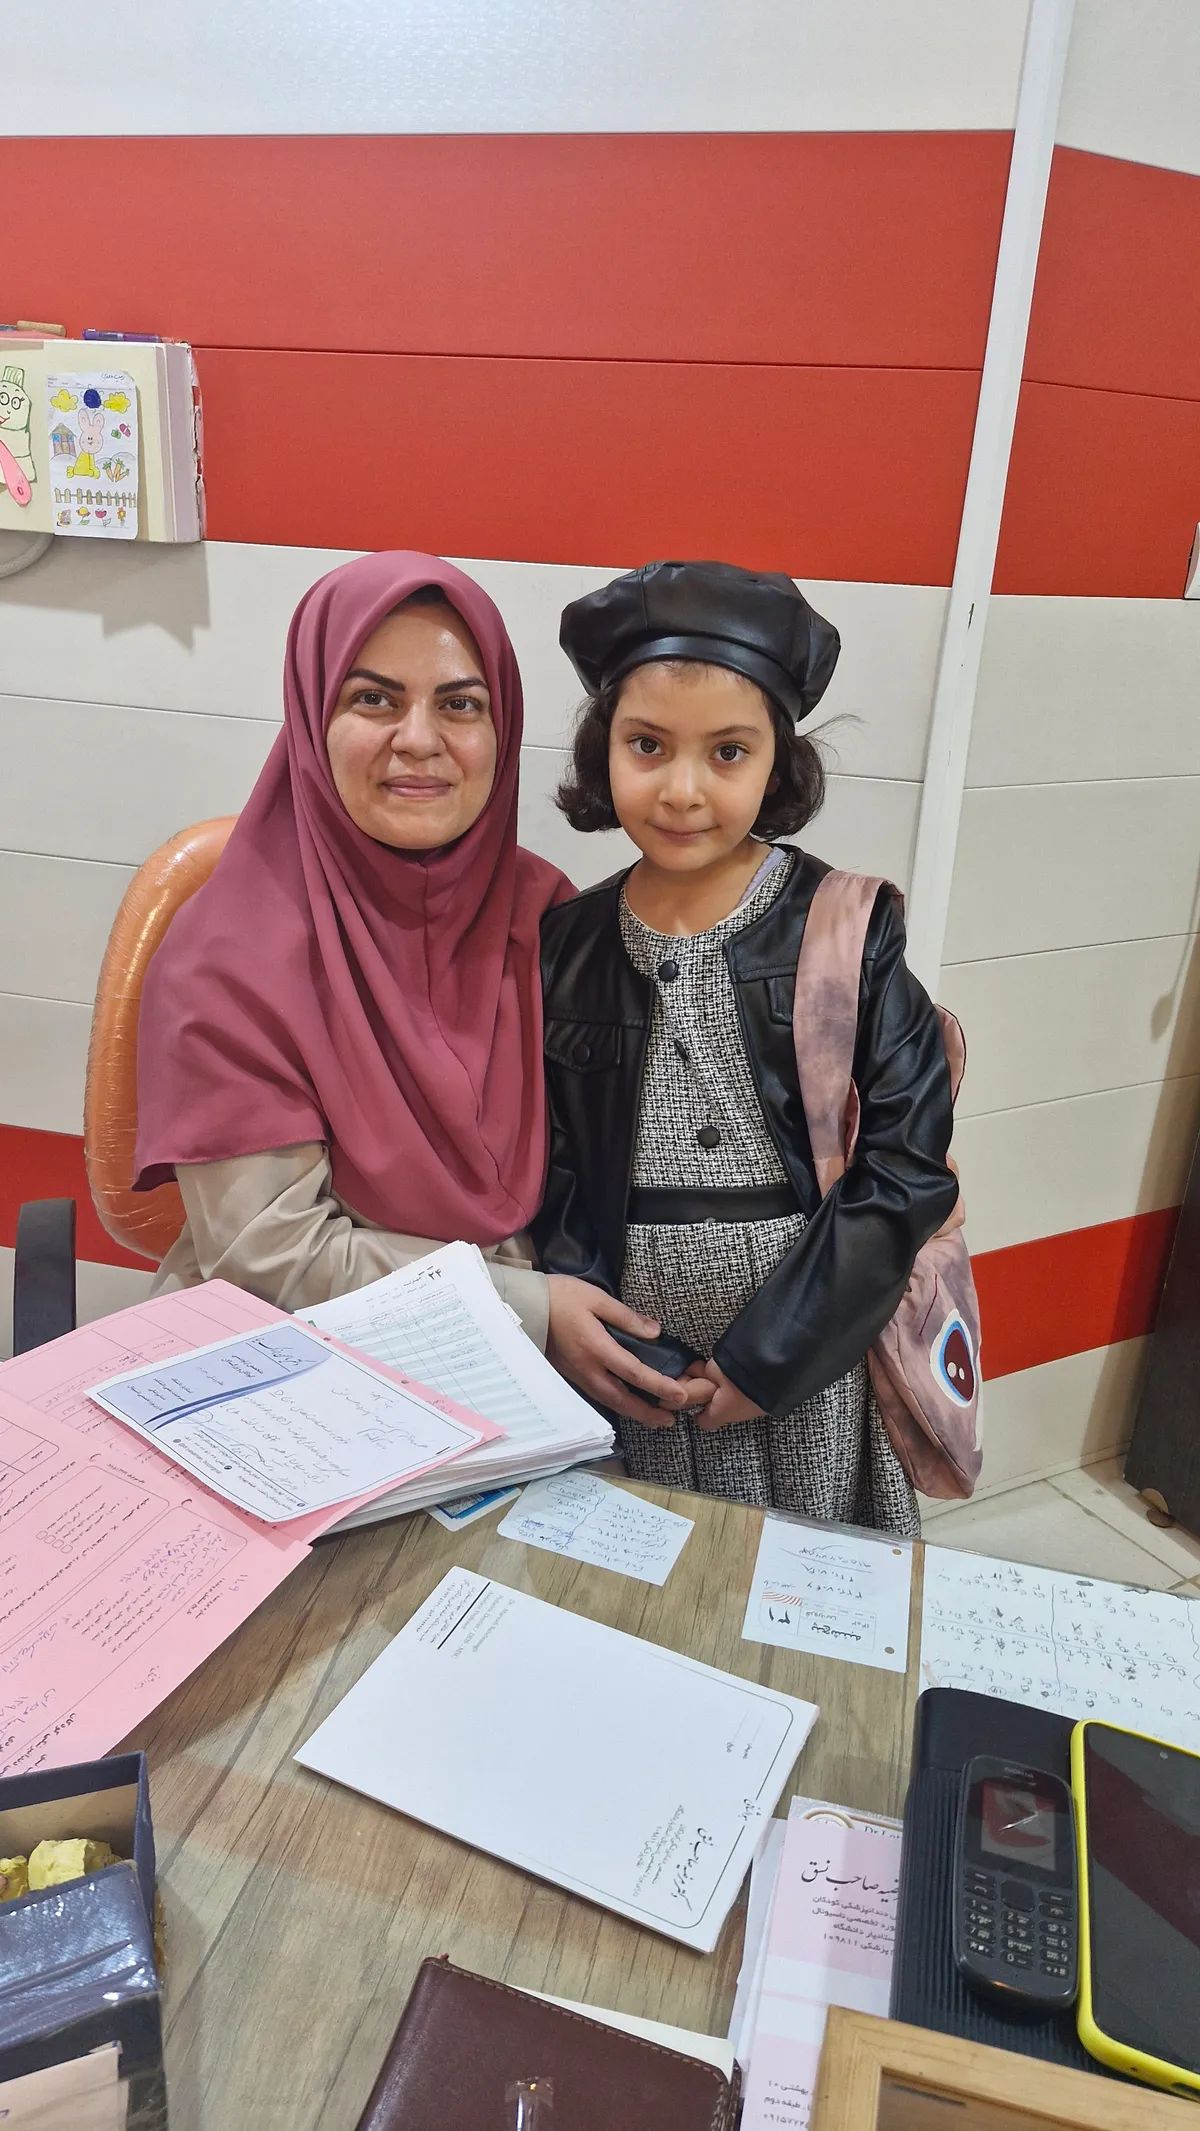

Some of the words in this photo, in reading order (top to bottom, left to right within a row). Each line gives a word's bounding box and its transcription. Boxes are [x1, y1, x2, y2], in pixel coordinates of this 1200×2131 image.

[768, 1607, 791, 1625] ۳۱
[801, 1860, 832, 1883] نسق
[825, 1876, 879, 1891] صاحب
[812, 1896, 841, 1907] کودکان
